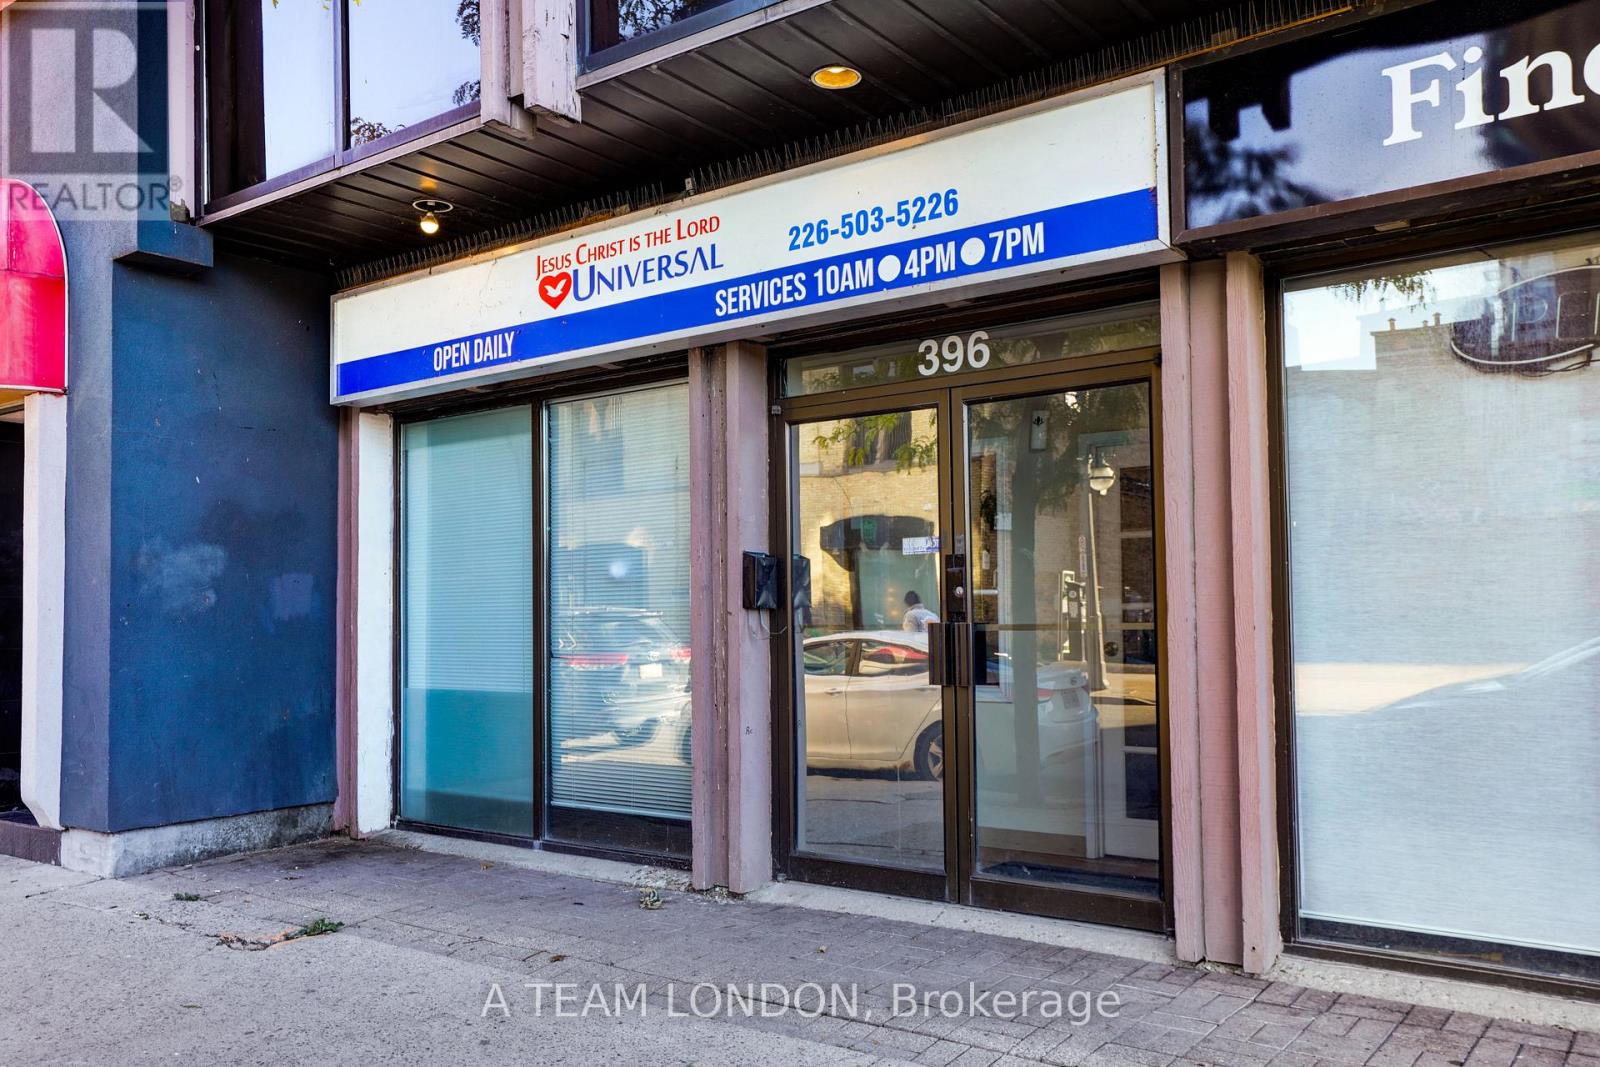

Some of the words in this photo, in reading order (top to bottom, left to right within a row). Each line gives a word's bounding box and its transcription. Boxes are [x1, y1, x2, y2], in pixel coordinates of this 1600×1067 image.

[536, 254, 572, 281] JESUS
[575, 243, 625, 265] CHRIST
[676, 215, 721, 241] LORD
[788, 188, 959, 251] 226-503-5226
[572, 243, 724, 302] UNIVERSAL
[715, 272, 807, 317] SERVICES
[813, 257, 874, 297] 10AM
[904, 240, 956, 279] 4PM
[988, 221, 1045, 263] 7PM
[433, 340, 470, 372] OPEN
[474, 331, 515, 363] DAILY
[917, 330, 990, 376] 396
